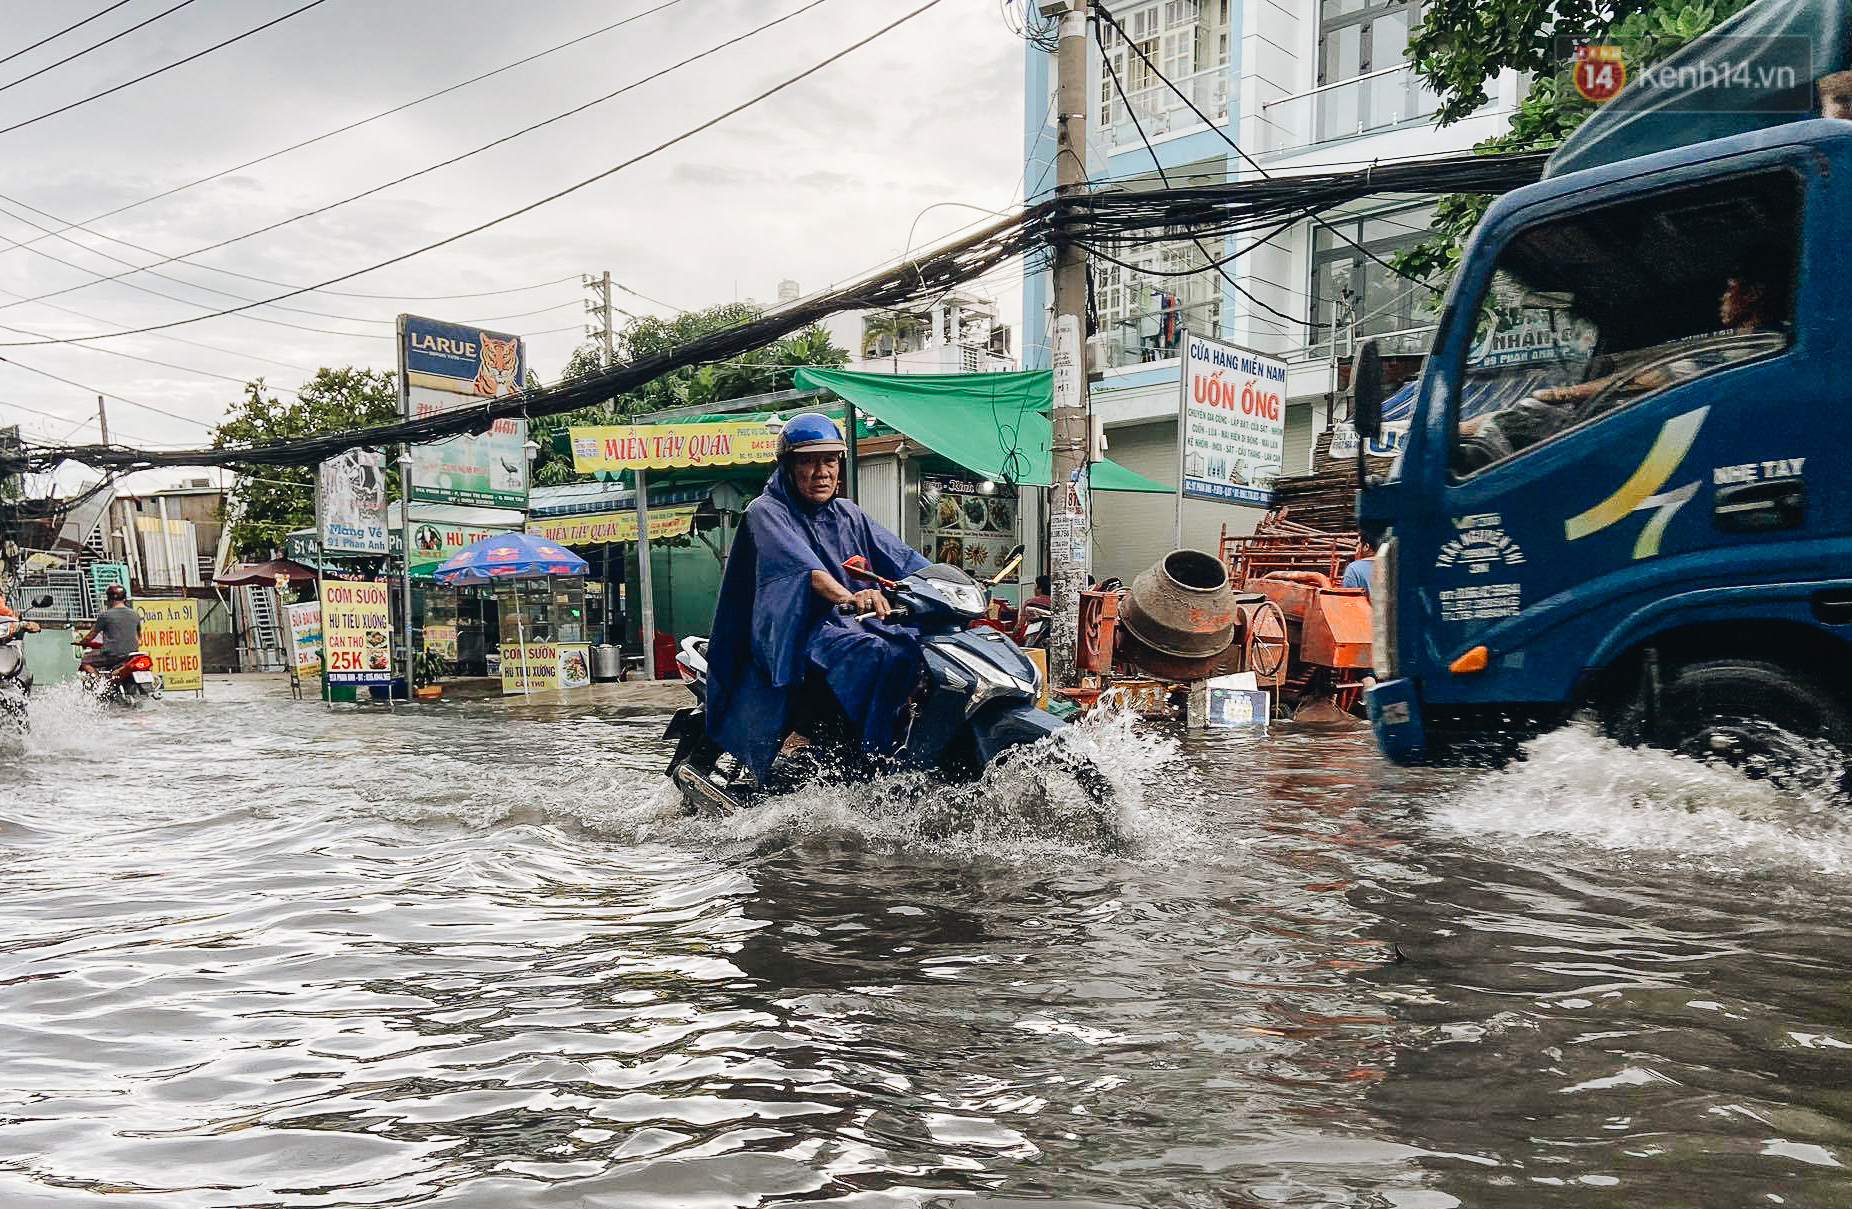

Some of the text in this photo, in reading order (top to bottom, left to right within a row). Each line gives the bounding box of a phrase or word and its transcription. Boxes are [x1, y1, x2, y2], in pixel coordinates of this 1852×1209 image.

[412, 333, 476, 357] LARUE
[1213, 347, 1238, 373] HÀNG
[1266, 364, 1286, 383] NAM
[1194, 370, 1279, 422] UỐN ỐNG
[653, 430, 687, 458] TÂY
[689, 429, 733, 463] QUÁN
[447, 527, 464, 546] HỦ
[327, 584, 387, 604] CƠM SƯỜN
[329, 608, 340, 628] HỦ
[342, 608, 360, 629] TIẾU
[180, 655, 198, 671] HEO
[331, 652, 363, 669] 25K
